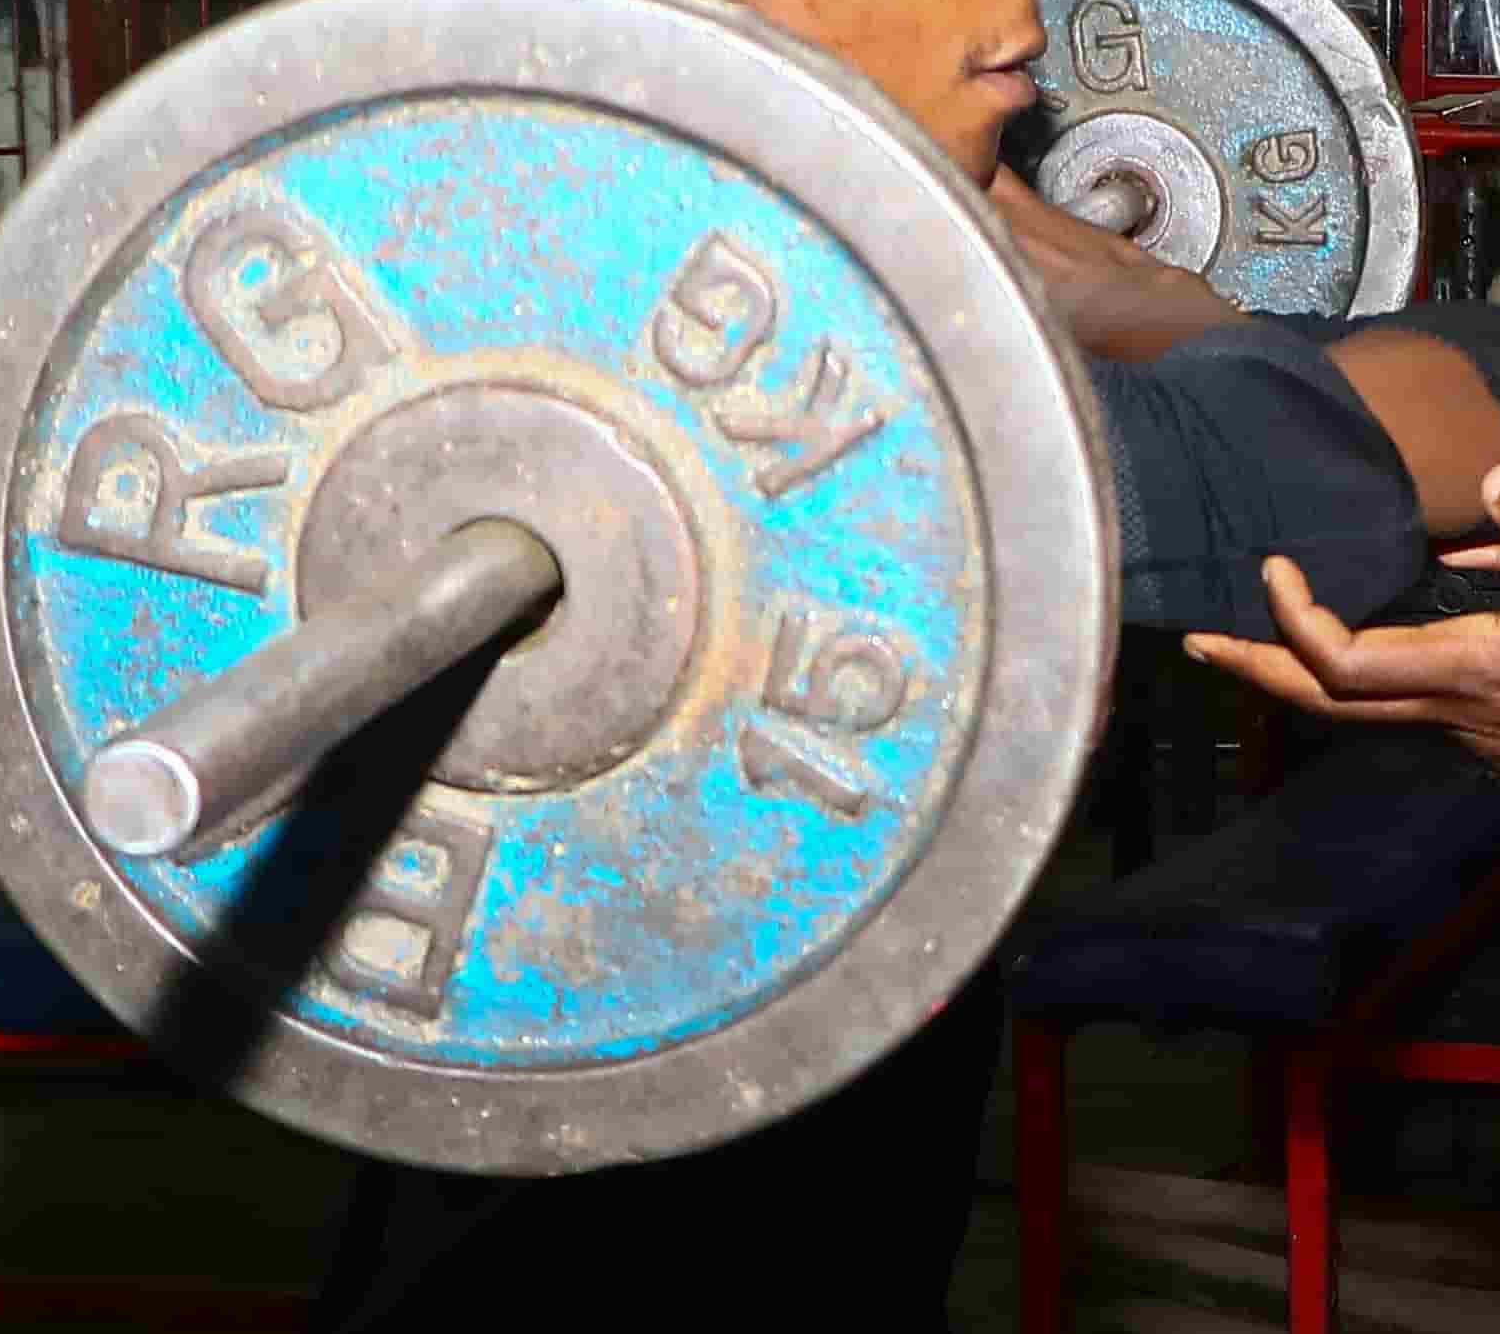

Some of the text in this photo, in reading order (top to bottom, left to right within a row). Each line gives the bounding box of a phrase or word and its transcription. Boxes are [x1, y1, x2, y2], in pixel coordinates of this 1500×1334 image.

[1250, 128, 1329, 247] KG
[652, 231, 908, 819] 15 KG
